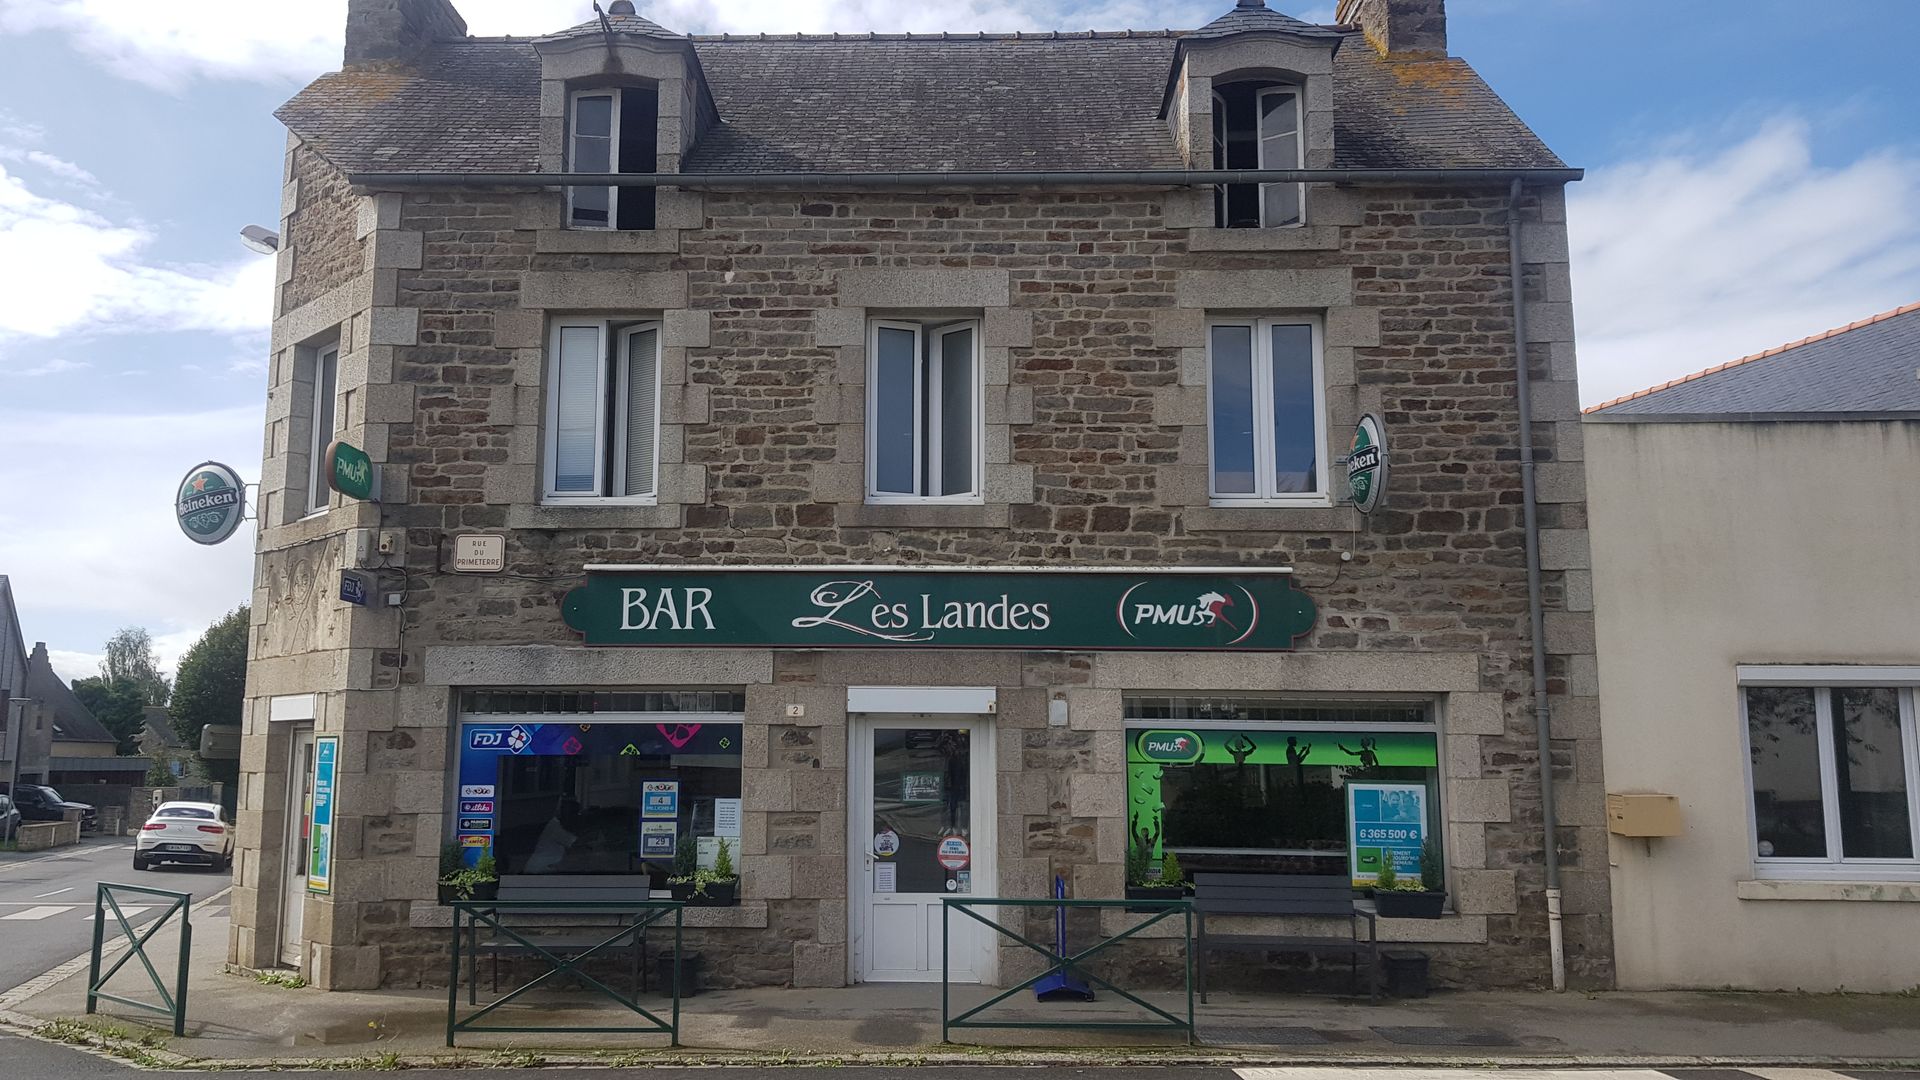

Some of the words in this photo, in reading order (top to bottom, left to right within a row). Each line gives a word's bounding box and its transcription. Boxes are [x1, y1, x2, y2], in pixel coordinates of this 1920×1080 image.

[337, 457, 357, 481] PMU
[179, 493, 234, 516] Heineken
[457, 558, 500, 566] PRIMETERRE
[619, 587, 717, 630] BAR
[791, 580, 935, 642] Les
[920, 593, 1051, 631] Landes
[1134, 604, 1197, 625] PMU
[792, 706, 799, 715] 2
[473, 733, 502, 745] FDJ
[1147, 741, 1174, 752] PMU
[1360, 829, 1367, 839] 6
[1367, 829, 1387, 839] 365
[1388, 830, 1407, 840] 500
[1409, 830, 1418, 840] €
[655, 837, 666, 846] 29
